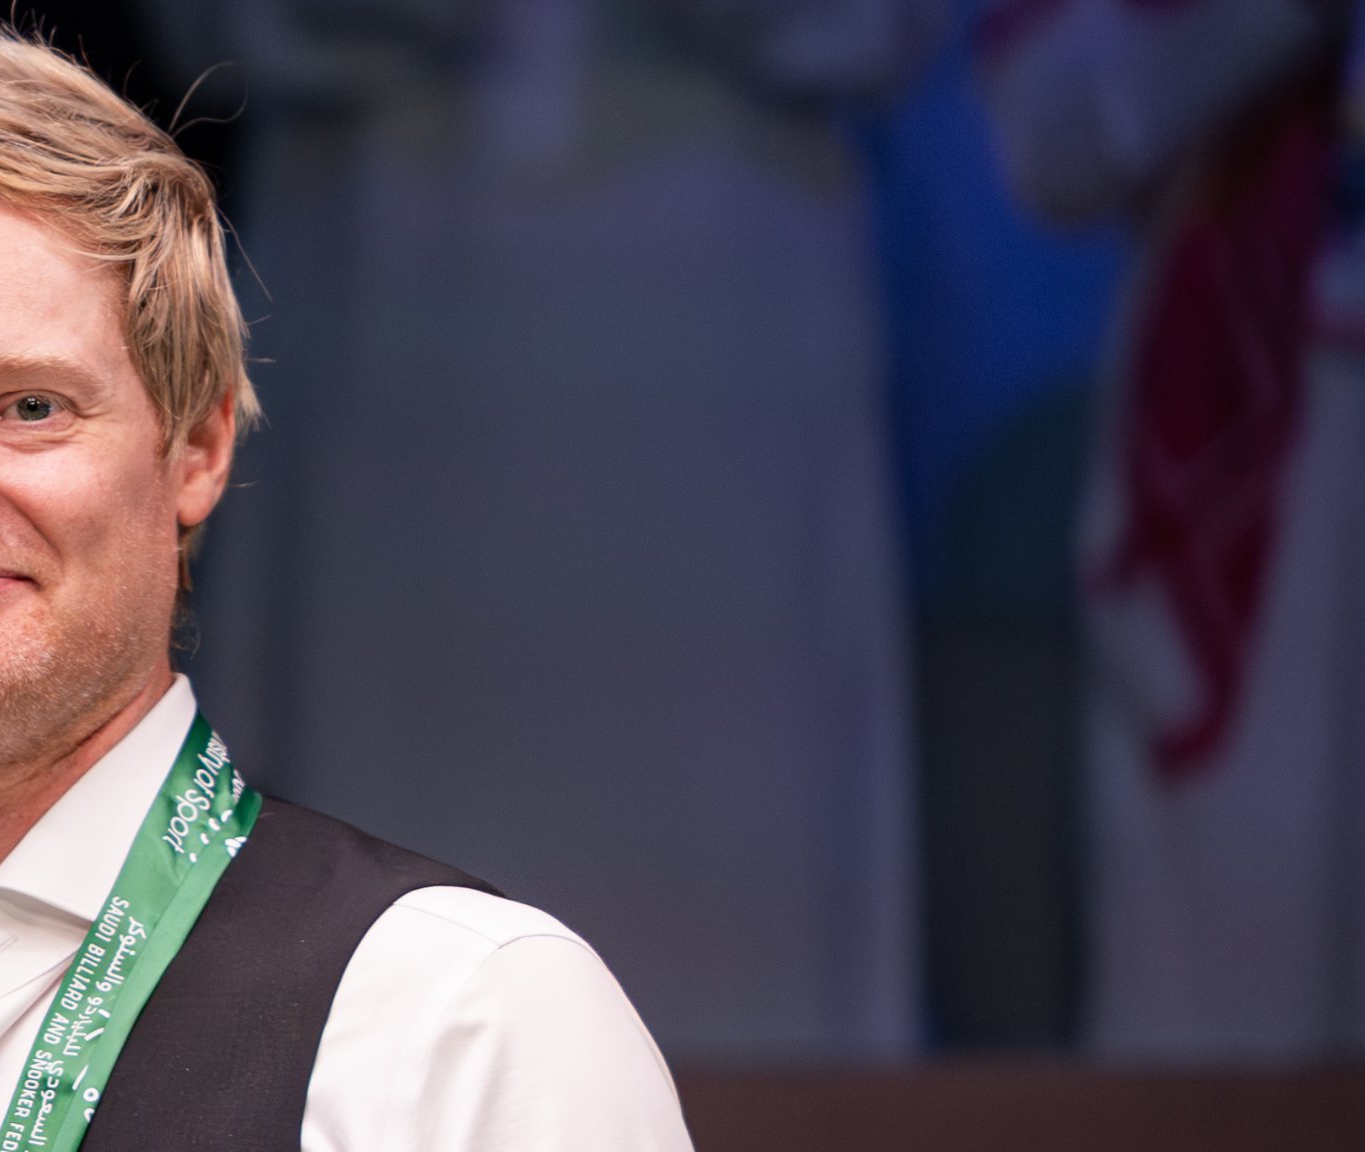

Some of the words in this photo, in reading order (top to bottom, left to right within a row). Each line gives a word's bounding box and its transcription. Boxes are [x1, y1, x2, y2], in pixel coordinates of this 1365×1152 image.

[193, 769, 215, 798] of
[162, 789, 210, 853] Sport
[94, 896, 129, 943] SAUDI
[60, 942, 105, 1011] BILLIARD
[29, 1059, 64, 1146] السعودي
[95, 916, 147, 992] والسنوكر
[43, 1012, 71, 1045] AND
[14, 1049, 53, 1118] SNOOKER
